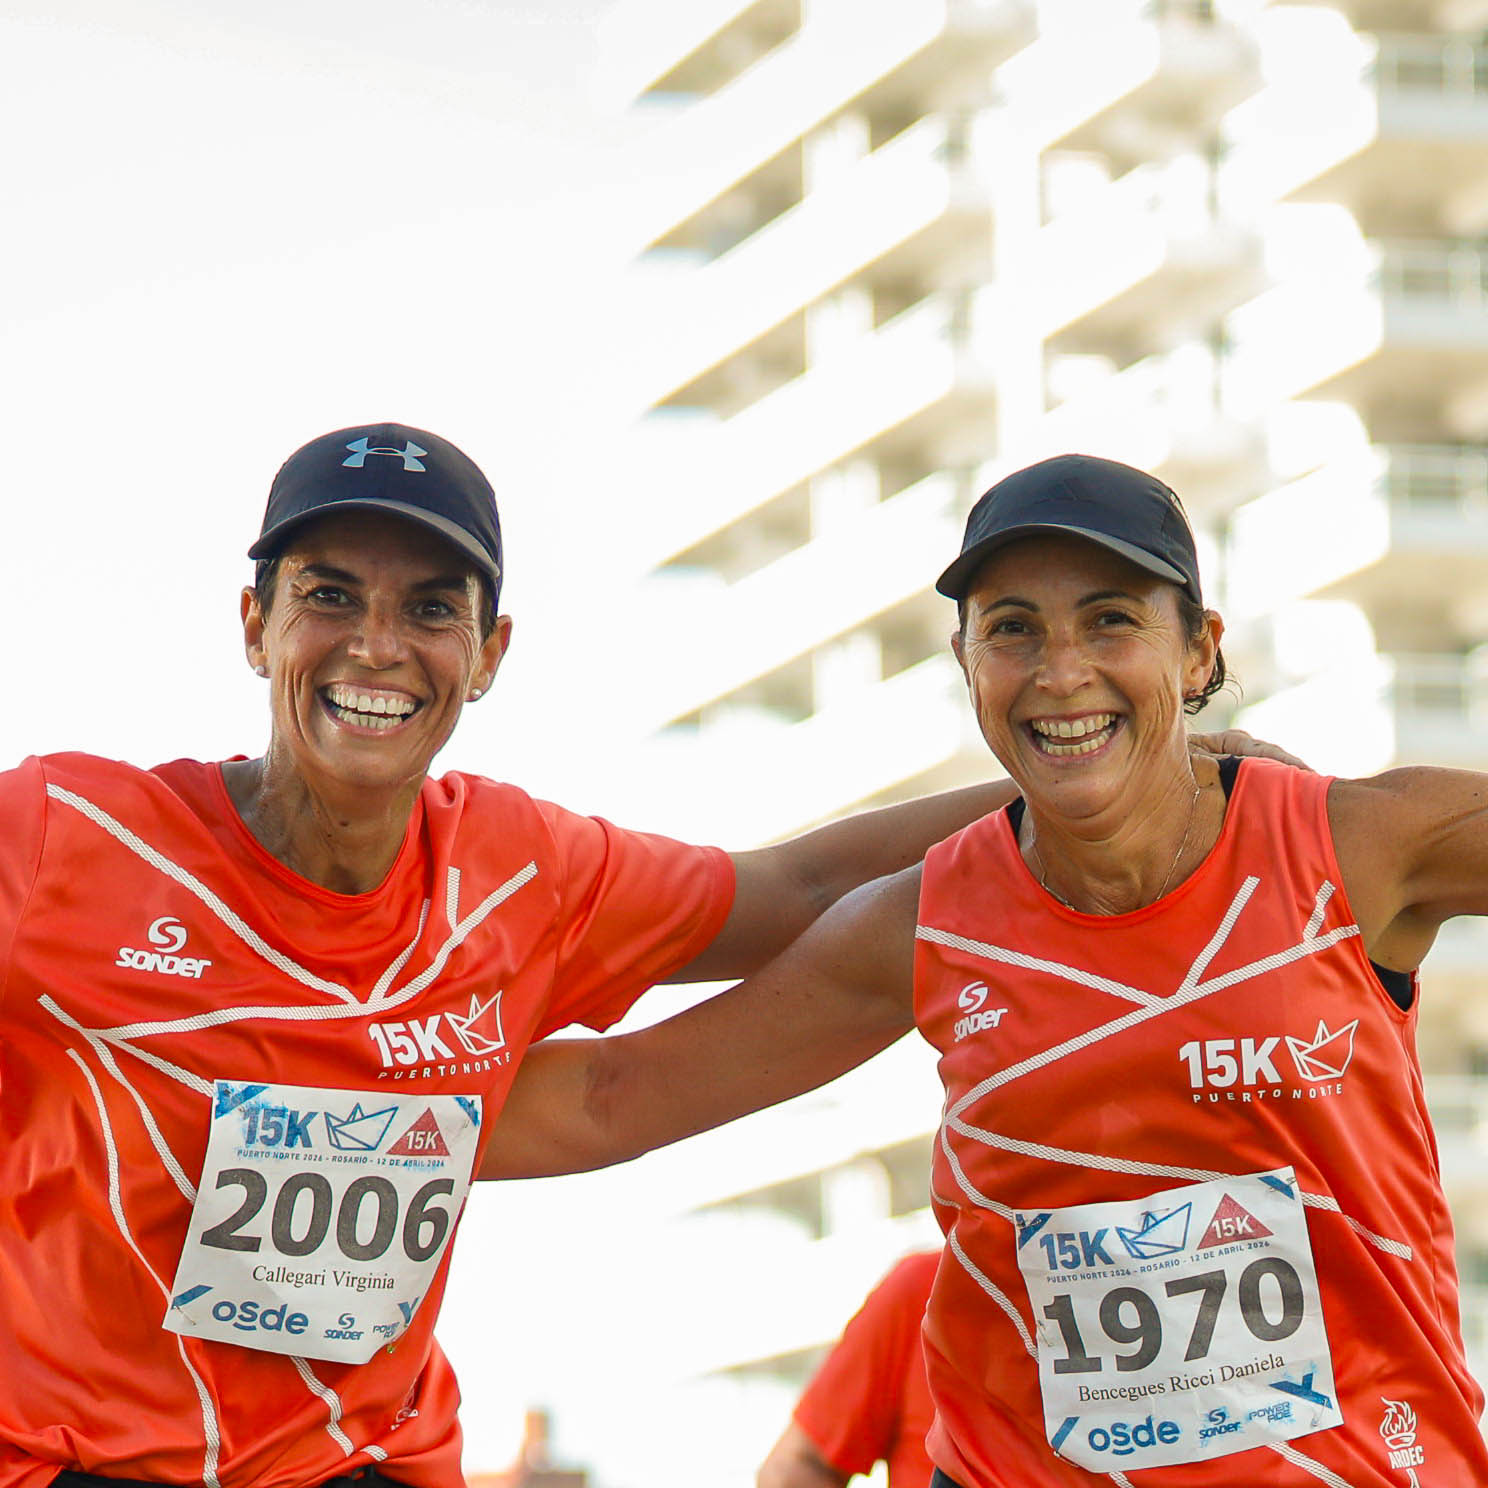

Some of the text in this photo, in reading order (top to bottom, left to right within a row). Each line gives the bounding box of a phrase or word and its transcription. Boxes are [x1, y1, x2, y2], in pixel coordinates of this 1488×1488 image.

[368, 1014, 456, 1068] 15K
[377, 1051, 511, 1080] PUERTO NORTE
[1178, 1036, 1283, 1089] 15K
[1192, 1083, 1343, 1104] PUERTO NORTE
[242, 1106, 321, 1149] 15K
[405, 1129, 440, 1150] 15K
[237, 1149, 271, 1159] PUERTO
[273, 1151, 300, 1161] NORTE
[303, 1154, 323, 1163] 2026
[331, 1155, 368, 1165] ROSARIO
[376, 1158, 386, 1166] 12
[389, 1159, 400, 1167] DE
[402, 1159, 425, 1168] ABRIL
[199, 1168, 455, 1262] 2006
[1211, 1214, 1254, 1240] 15K
[1039, 1227, 1115, 1271] 15K
[1046, 1273, 1078, 1284] PUERTO
[1080, 1270, 1108, 1281] NORTE
[1111, 1268, 1132, 1278] 2026
[1140, 1258, 1181, 1273] ROSARIO
[1190, 1254, 1200, 1264] 12
[1203, 1250, 1215, 1260] DE
[1218, 1245, 1244, 1257] ABRIL
[1247, 1241, 1271, 1251] 2026
[252, 1265, 395, 1293] Callegari Virginia
[212, 1300, 309, 1335] osde
[1043, 1256, 1305, 1375] 1970
[1078, 1354, 1286, 1404] Bencegues Ricci Daniela
[1249, 1401, 1290, 1421] POWER
[1088, 1416, 1181, 1455] osde
[1387, 1445, 1425, 1469] ARDEC
